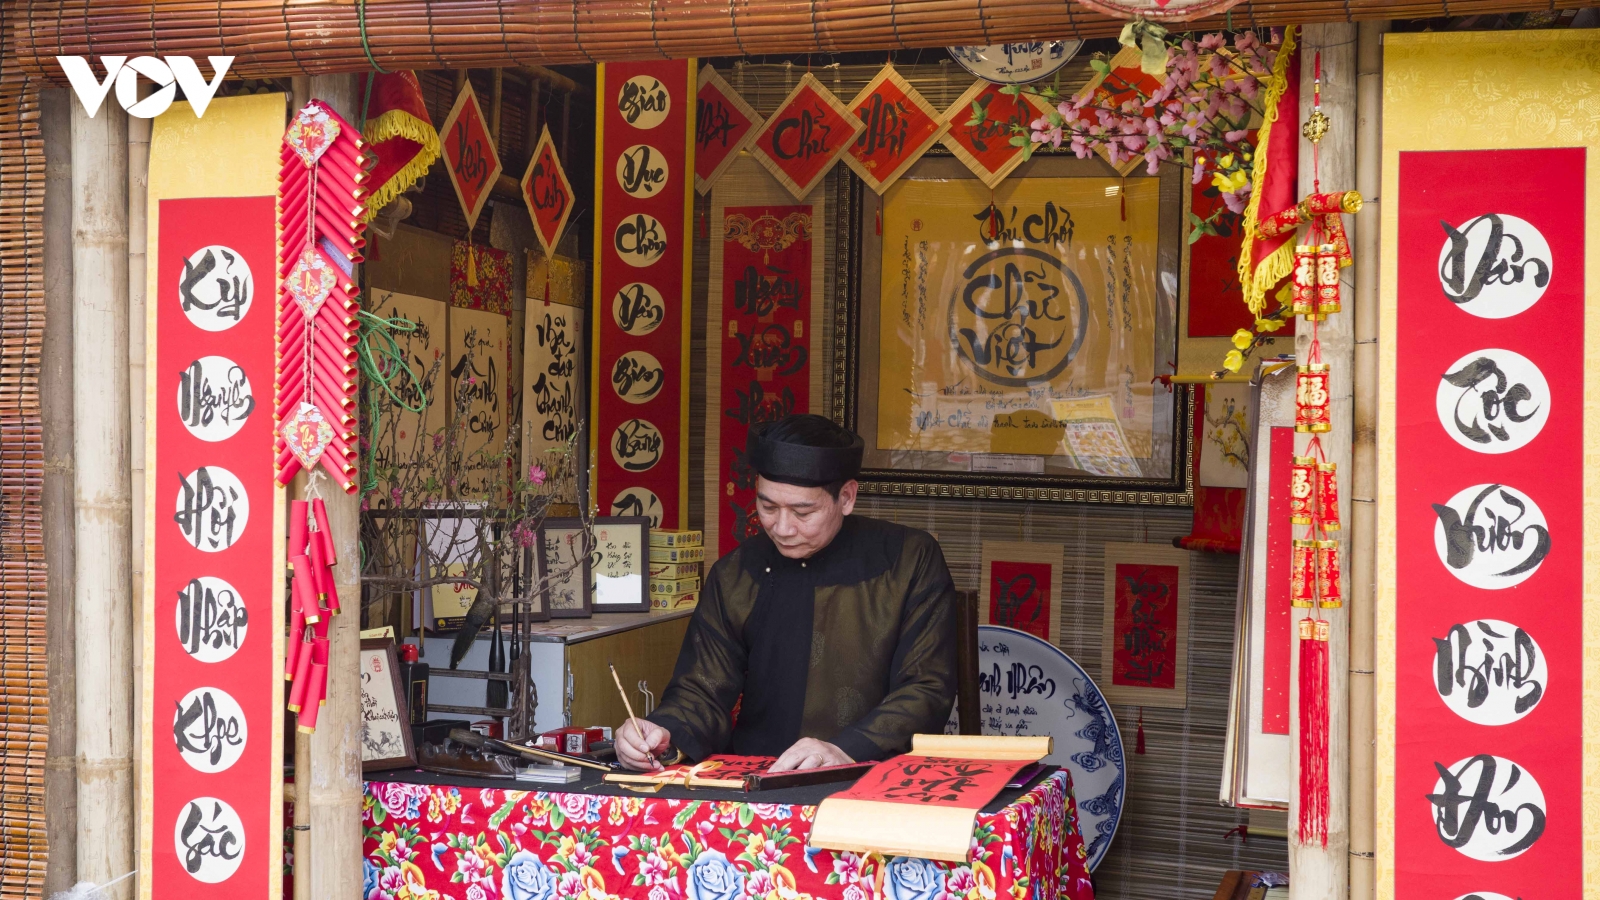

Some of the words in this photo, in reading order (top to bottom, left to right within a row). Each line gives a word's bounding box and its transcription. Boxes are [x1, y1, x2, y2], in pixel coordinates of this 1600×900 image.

[618, 80, 667, 123] Giáo
[772, 101, 831, 162] Chữ
[622, 145, 665, 193] Dục
[183, 249, 250, 321] Kỷ
[1318, 256, 1340, 286] 福
[1440, 212, 1550, 304] Dân
[734, 265, 805, 317] Ngày
[962, 262, 1066, 323] Chữ
[731, 323, 808, 376] Xuân
[958, 317, 1067, 376] Việt
[180, 360, 255, 428] Nguyên
[1440, 356, 1541, 444] Tộc
[174, 466, 238, 549] Hội
[1292, 469, 1310, 498] 福
[176, 578, 248, 655] Nhập
[1006, 662, 1056, 700] Nhân
[1425, 753, 1547, 855] Đón
[181, 801, 243, 874] Sắc
